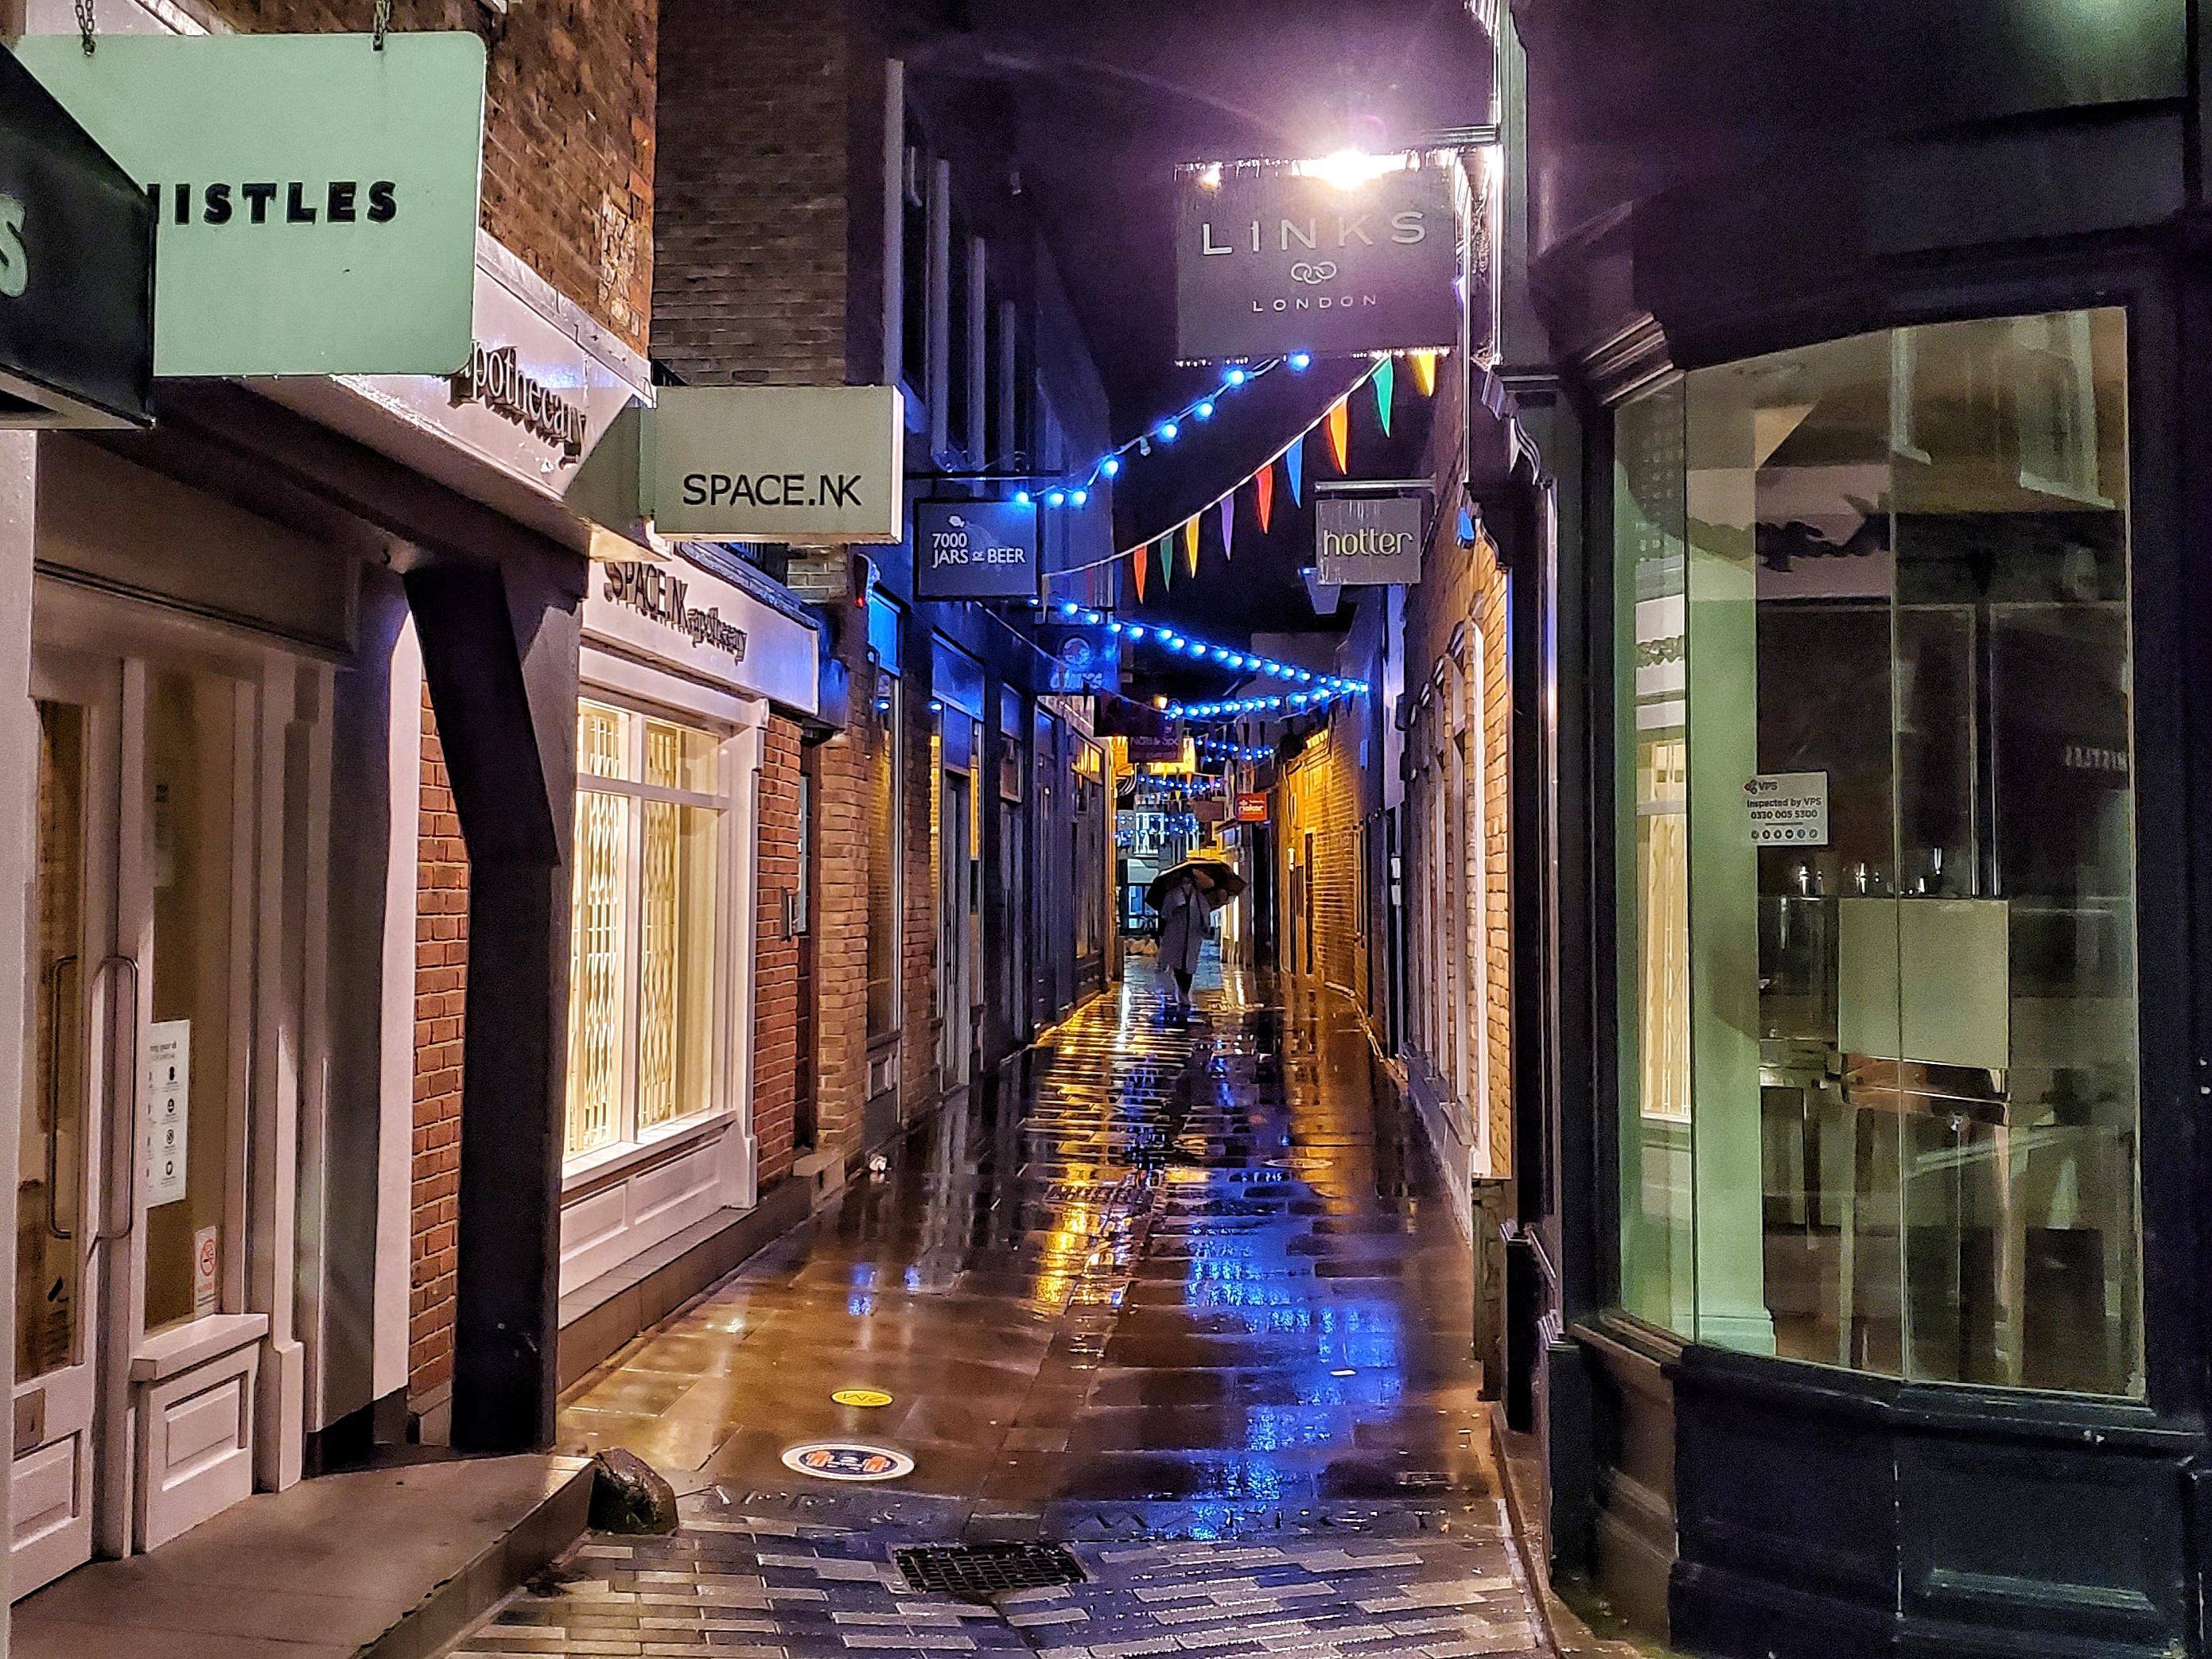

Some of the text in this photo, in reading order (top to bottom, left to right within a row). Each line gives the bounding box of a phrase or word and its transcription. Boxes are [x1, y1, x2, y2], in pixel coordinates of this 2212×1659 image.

[1202, 210, 1426, 255] LINKS
[1253, 294, 1376, 312] LONDON
[683, 474, 862, 507] SPACE.NK
[932, 533, 967, 548] 7000
[1323, 528, 1413, 556] hotter
[932, 550, 968, 569] JARS
[987, 548, 1026, 564] BEER
[1758, 781, 1778, 791] VPS
[1746, 797, 1821, 809] Inspected by VPS
[1751, 810, 1773, 820] 0330
[1775, 810, 1792, 819] 005
